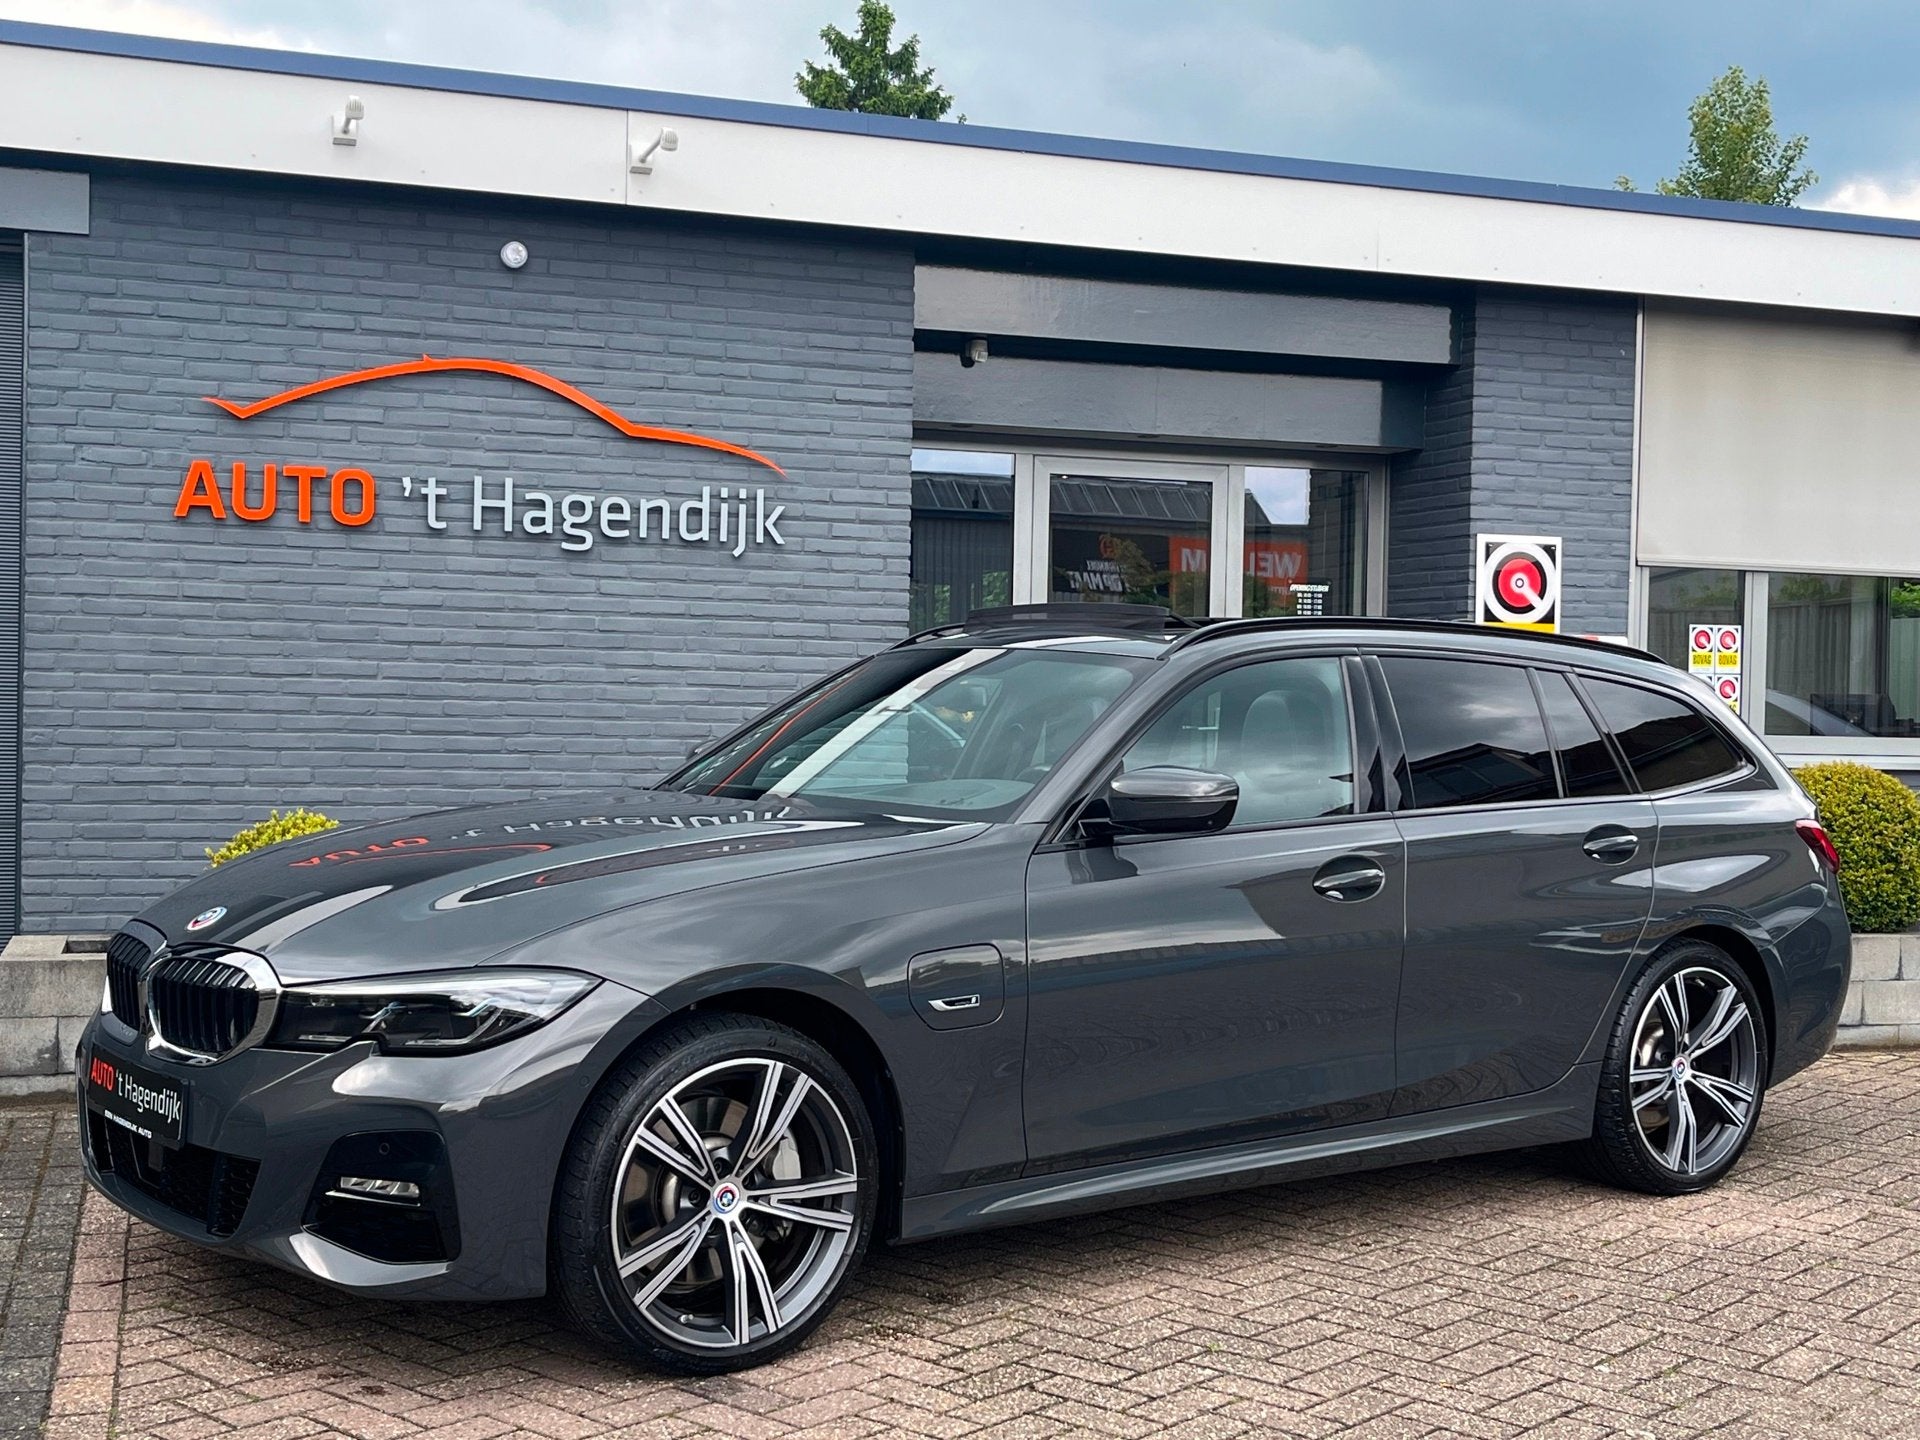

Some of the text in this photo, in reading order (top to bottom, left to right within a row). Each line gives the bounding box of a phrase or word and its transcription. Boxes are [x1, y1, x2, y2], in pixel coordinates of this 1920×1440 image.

[174, 460, 786, 557] AUTO 't Hagendijk
[91, 1057, 115, 1091] AUTO
[125, 1074, 181, 1124] Hagendijk
